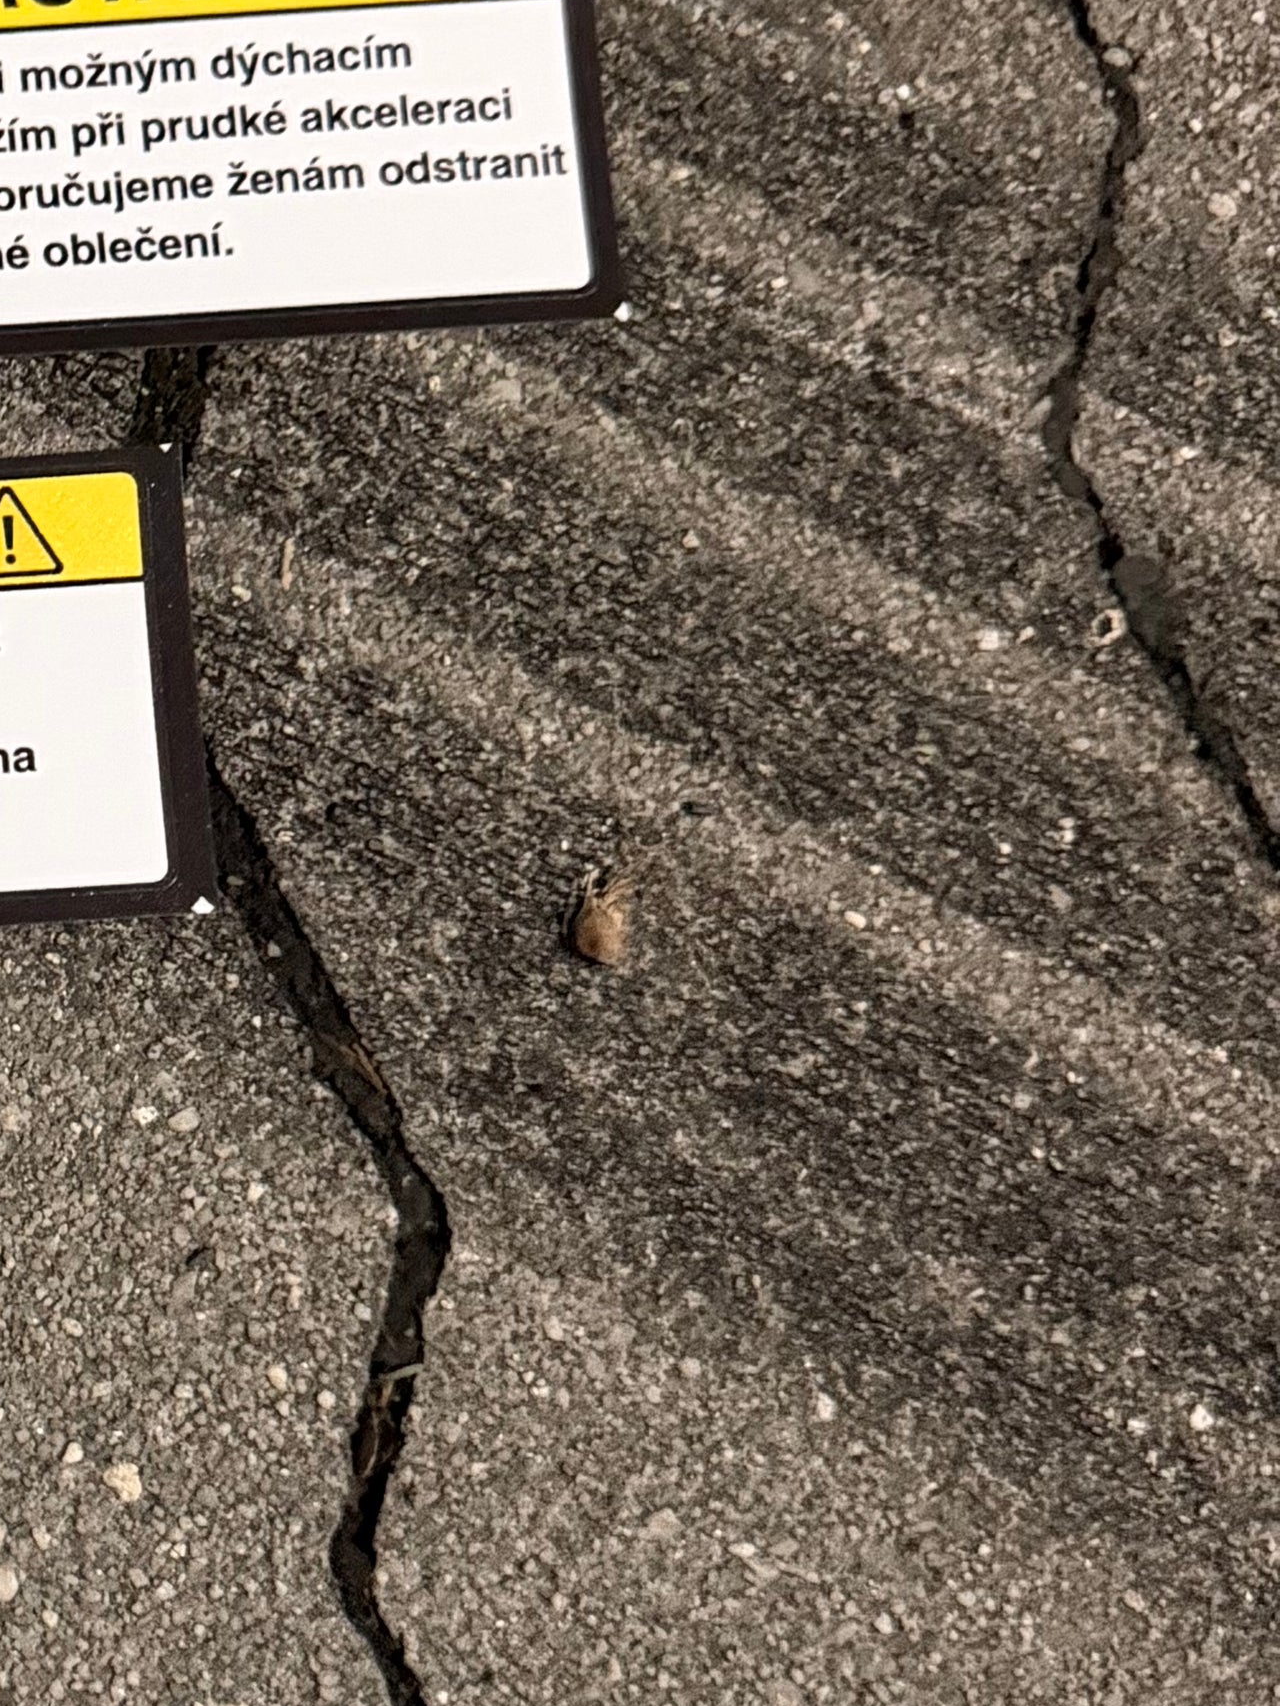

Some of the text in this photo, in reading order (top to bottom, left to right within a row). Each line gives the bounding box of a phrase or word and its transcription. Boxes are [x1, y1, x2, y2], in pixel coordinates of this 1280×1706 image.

[20, 49, 196, 94] možným
[210, 35, 412, 87] dýchacím
[71, 112, 125, 157] při
[141, 100, 287, 152] prudké
[301, 87, 512, 133] akceleraci
[227, 156, 365, 196] ženám
[379, 144, 567, 186] odstranit
[42, 221, 234, 268] oblečení.
